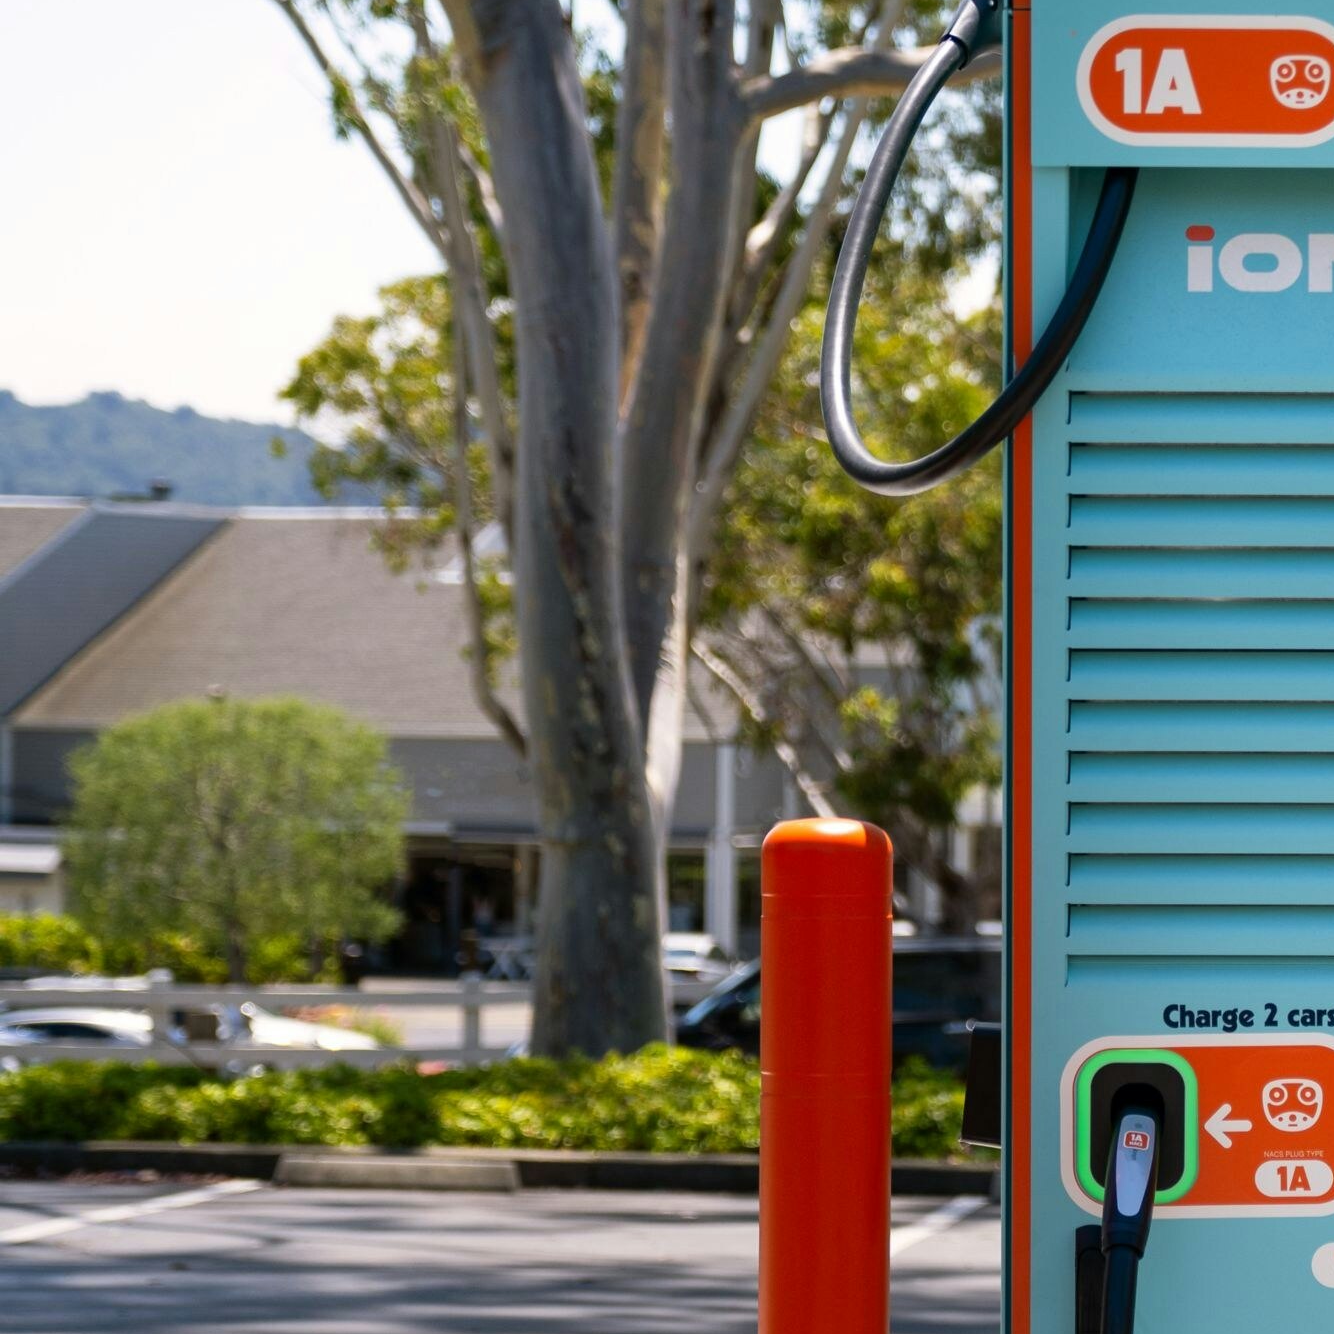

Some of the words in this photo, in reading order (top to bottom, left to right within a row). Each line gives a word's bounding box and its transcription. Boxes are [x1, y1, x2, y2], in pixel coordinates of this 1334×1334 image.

[1115, 48, 1202, 115] 1A
[1163, 1003, 1254, 1033] Charge
[1264, 1003, 1278, 1027] 2
[1130, 1134, 1143, 1142] 1A
[1306, 1150, 1325, 1158] TYPE
[1277, 1166, 1311, 1192] 1A
